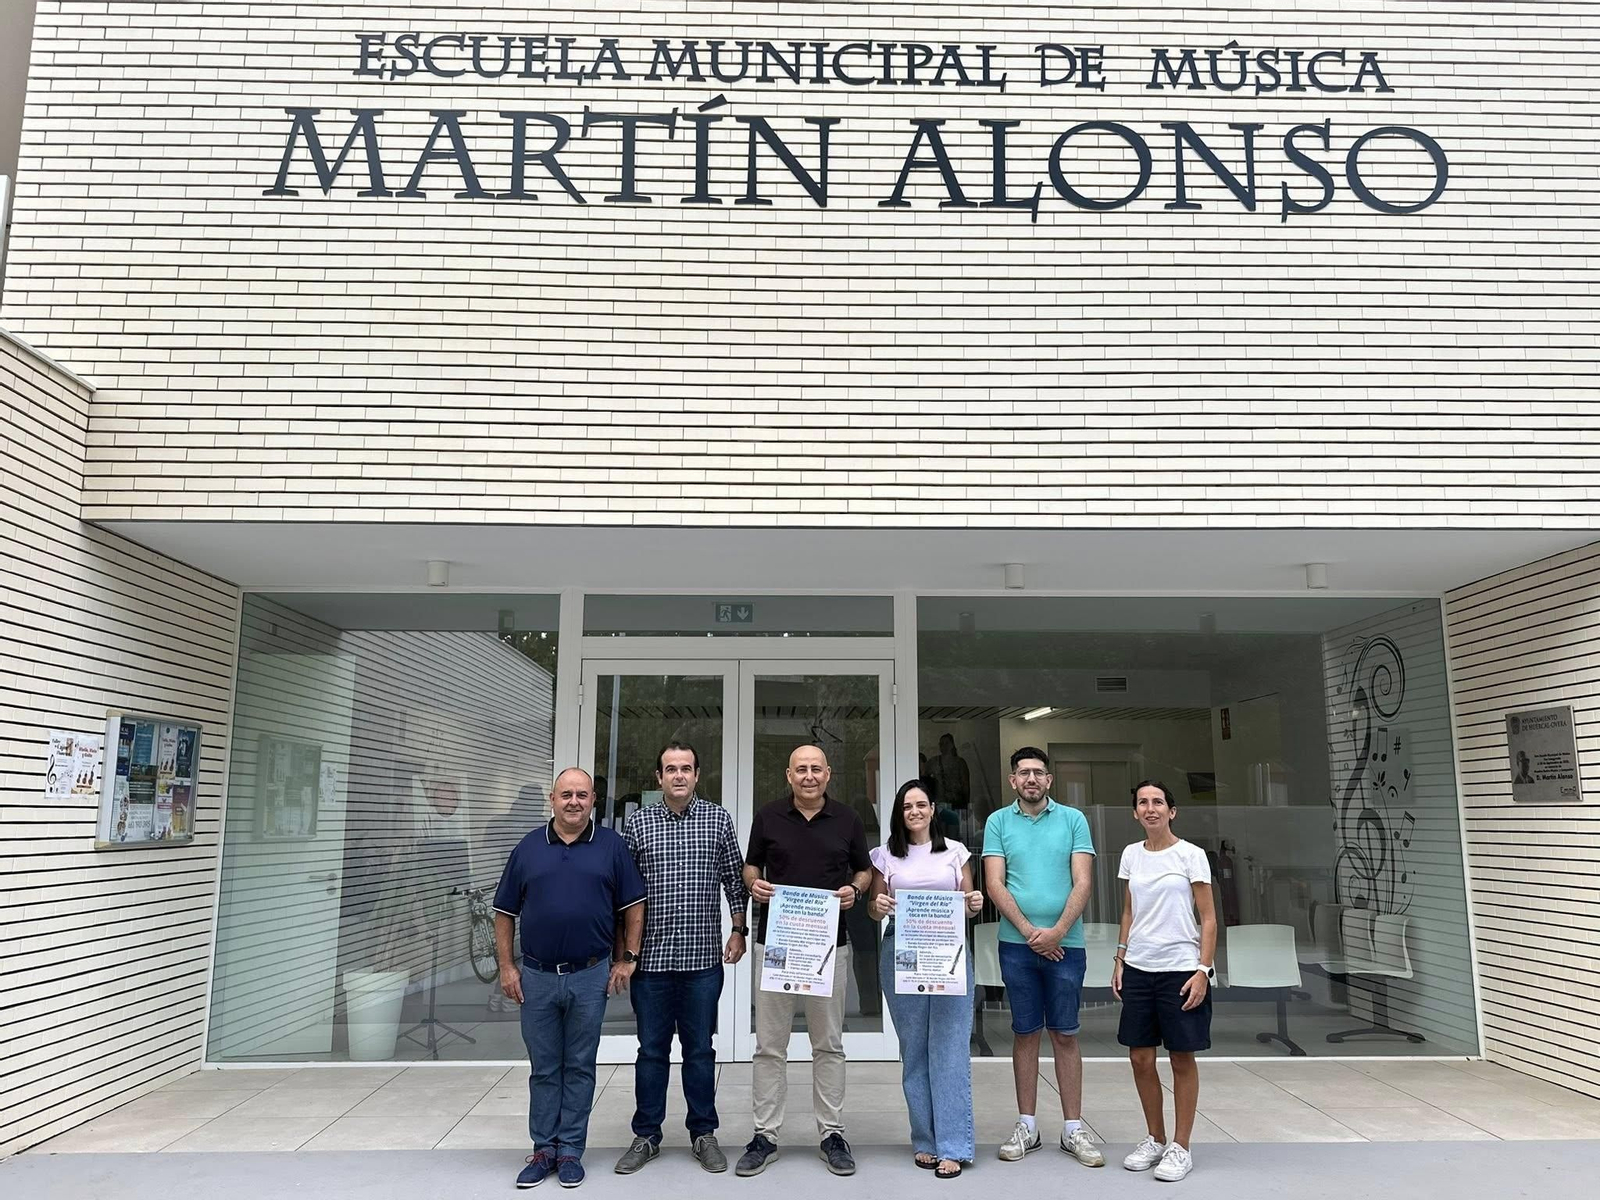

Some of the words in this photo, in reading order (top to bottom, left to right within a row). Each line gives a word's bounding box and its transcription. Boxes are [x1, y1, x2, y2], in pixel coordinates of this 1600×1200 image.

[353, 31, 631, 87] ESCUELA
[644, 38, 1007, 94] MUNICIPAL
[1035, 43, 1106, 93] DE
[1146, 40, 1395, 97] MÚSICA
[262, 94, 841, 208] MARTÍN
[878, 118, 1449, 223] ALONSO
[798, 916, 826, 924] descuento
